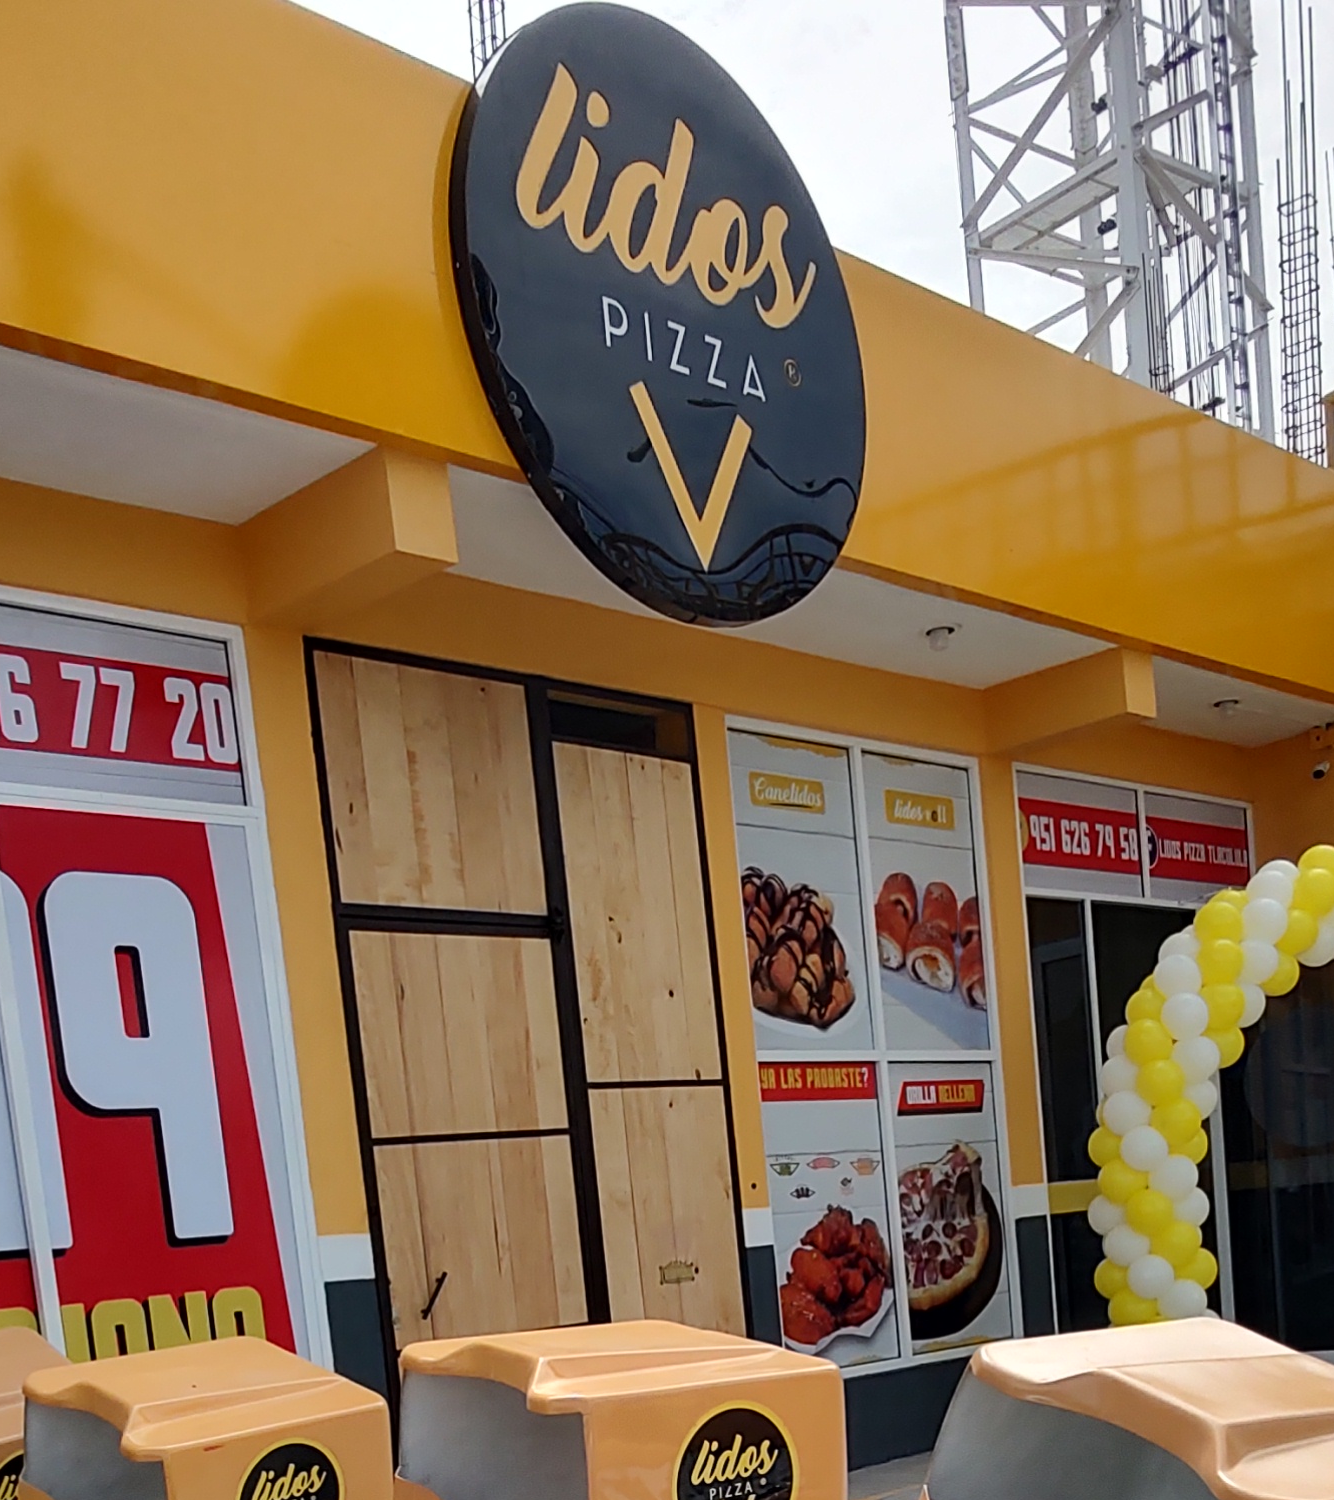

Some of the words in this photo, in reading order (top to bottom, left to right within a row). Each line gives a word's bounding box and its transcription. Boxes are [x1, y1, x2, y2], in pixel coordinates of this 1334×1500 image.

[515, 61, 817, 329] lidos
[601, 295, 767, 403] PIZZA
[59, 661, 137, 754] 77
[164, 676, 240, 766] 20
[894, 798, 923, 822] lidos
[1029, 814, 1056, 853] 951
[1060, 818, 1091, 856] 626
[1095, 822, 1116, 860] 79
[1119, 826, 1139, 862] 58
[1183, 841, 1206, 863] PIZZA
[760, 1067, 776, 1090] YA
[780, 1067, 803, 1089] LAS
[690, 1433, 779, 1486] lidos
